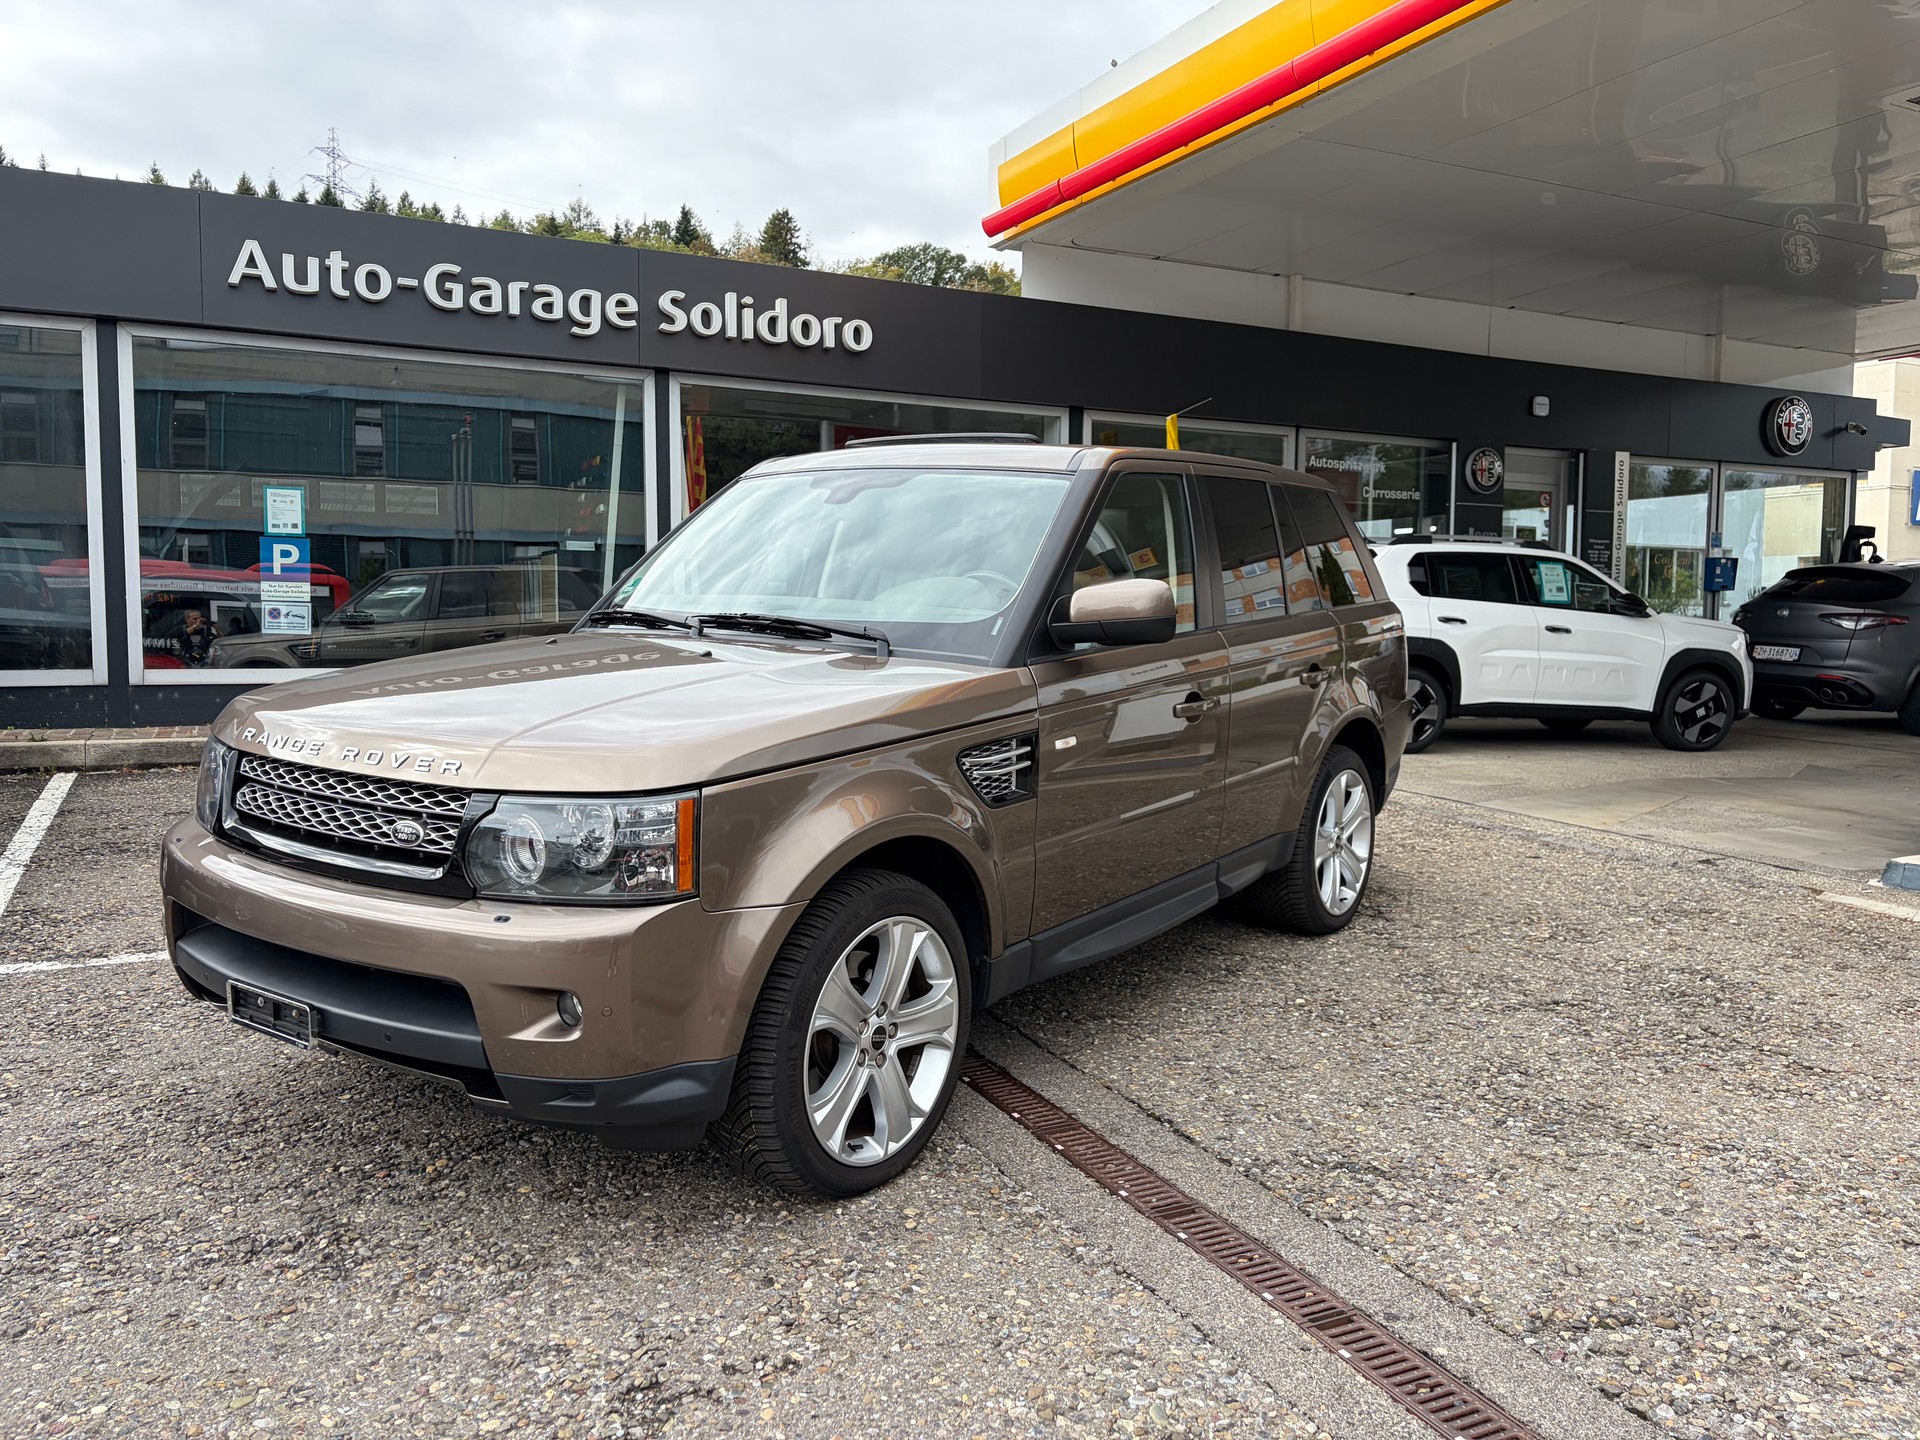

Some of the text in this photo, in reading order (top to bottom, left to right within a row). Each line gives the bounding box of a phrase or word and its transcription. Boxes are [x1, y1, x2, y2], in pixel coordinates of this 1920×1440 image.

[228, 239, 873, 352] Auto-Garage Solidoro
[1777, 401, 1791, 424] ALFA
[1308, 455, 1387, 473] Autospritzwerk
[1362, 486, 1421, 500] Carrosserie
[1614, 459, 1625, 583] Auto-Garage Solidoro
[272, 543, 300, 576] P
[241, 727, 463, 776] RANGE ROVER
